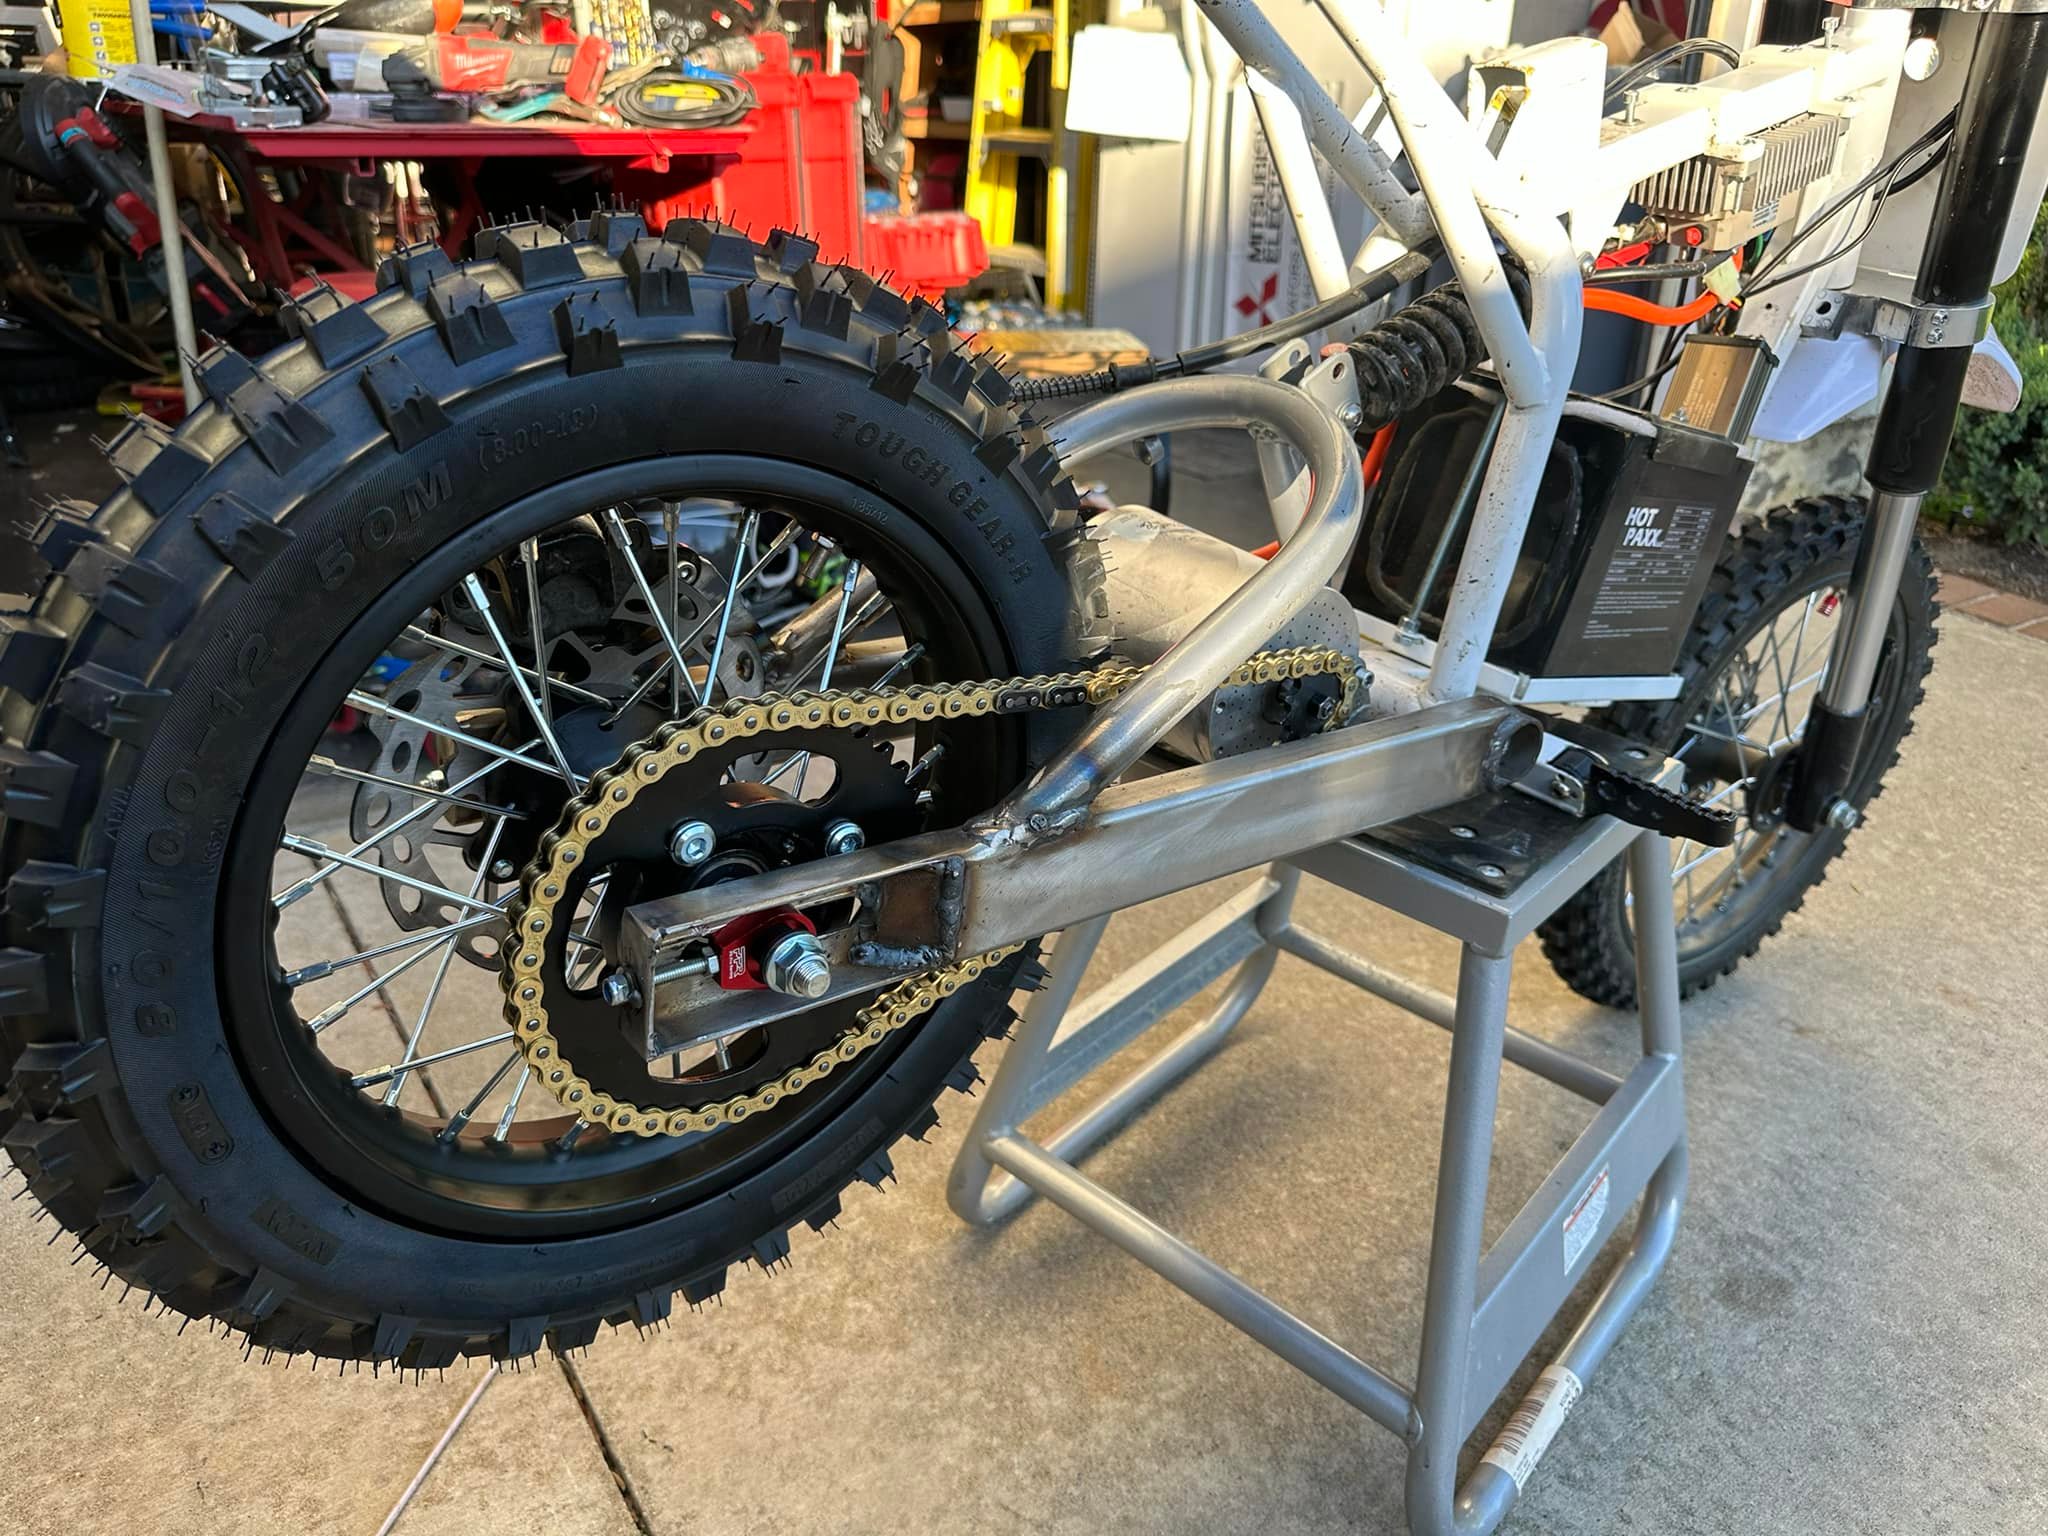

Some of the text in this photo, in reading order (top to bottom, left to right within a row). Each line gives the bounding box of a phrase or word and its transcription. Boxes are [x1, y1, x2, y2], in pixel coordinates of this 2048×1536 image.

[832, 399, 1033, 585] TOUGH GEAR-R
[1624, 506, 1660, 528] HOT
